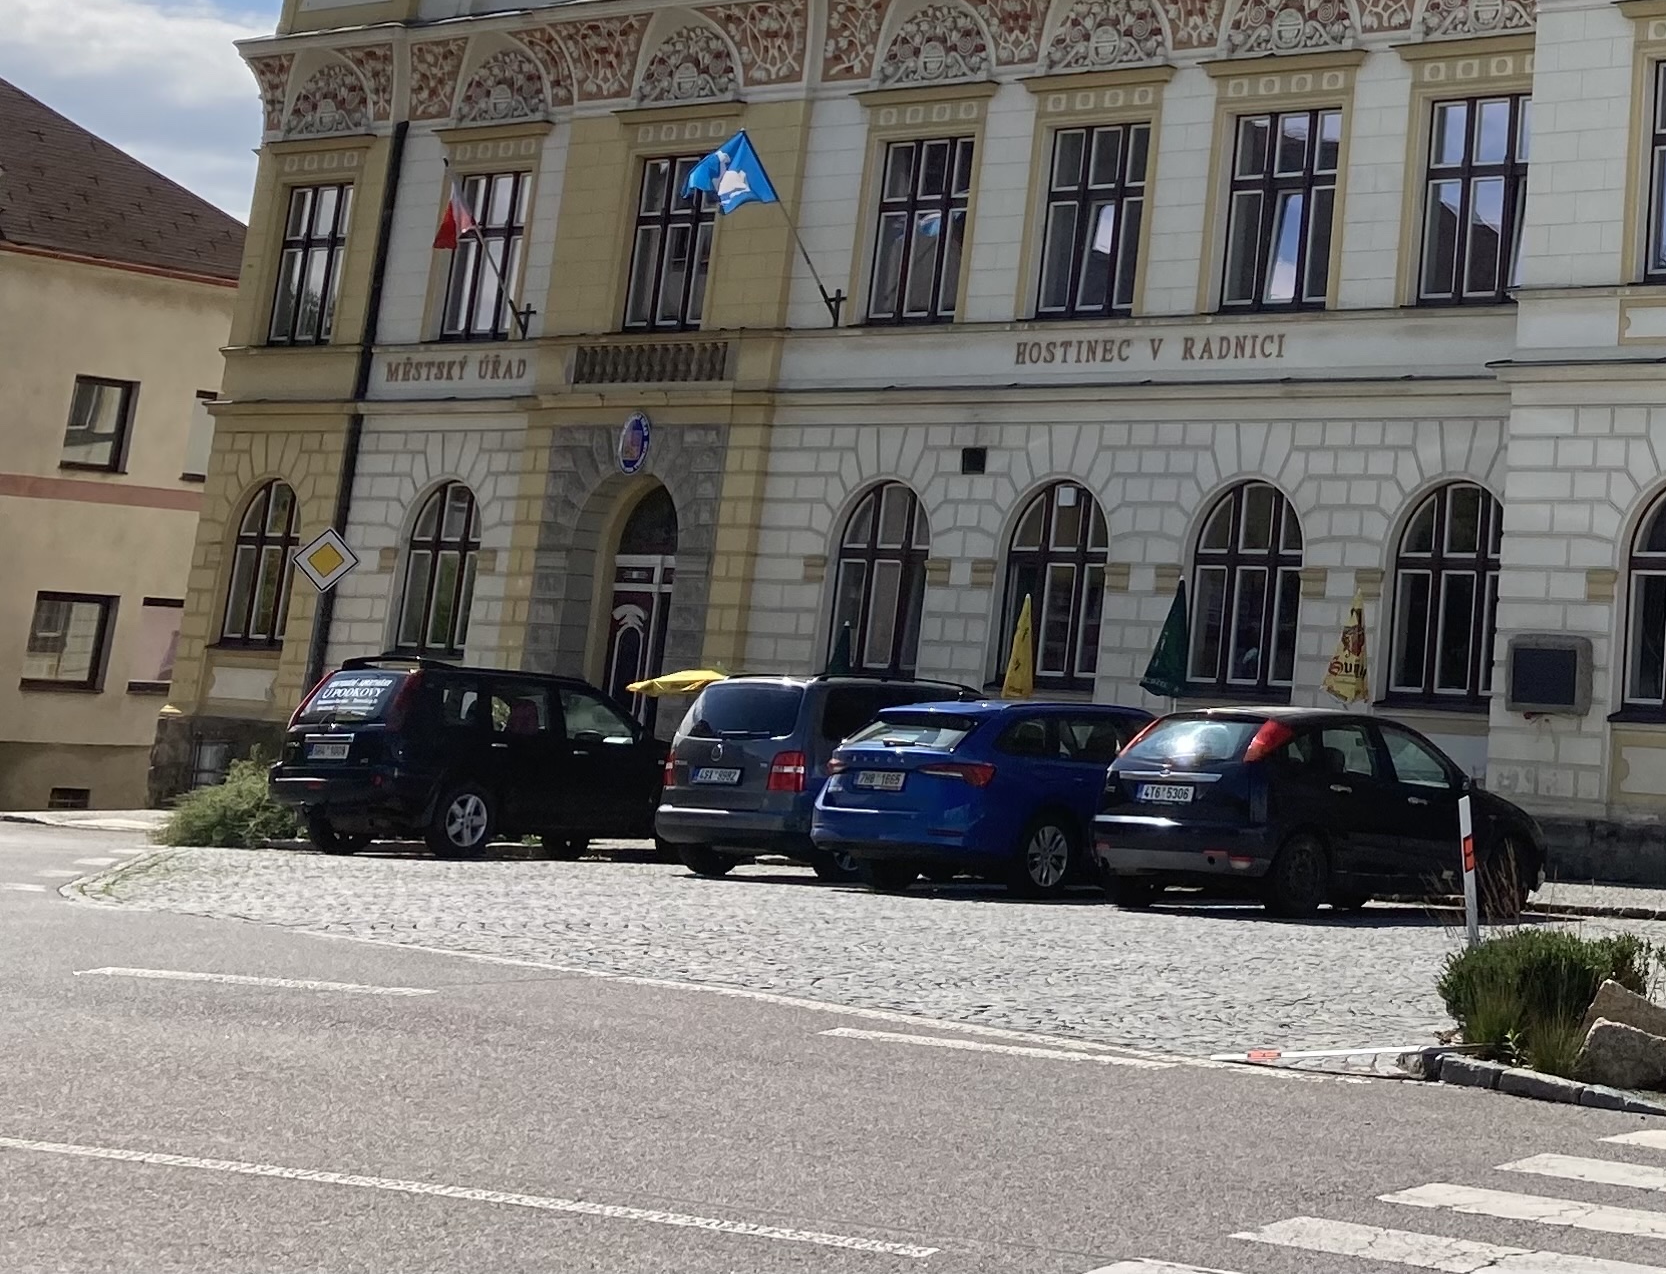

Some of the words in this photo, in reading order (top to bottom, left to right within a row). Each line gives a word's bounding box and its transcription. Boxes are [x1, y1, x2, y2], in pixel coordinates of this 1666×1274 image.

[1014, 339, 1131, 365] HOSTINEC
[1150, 338, 1164, 361] V
[1181, 333, 1286, 361] RADNICI
[385, 355, 468, 382] MĚSTSKÝ
[478, 354, 527, 380] ÚŘAD
